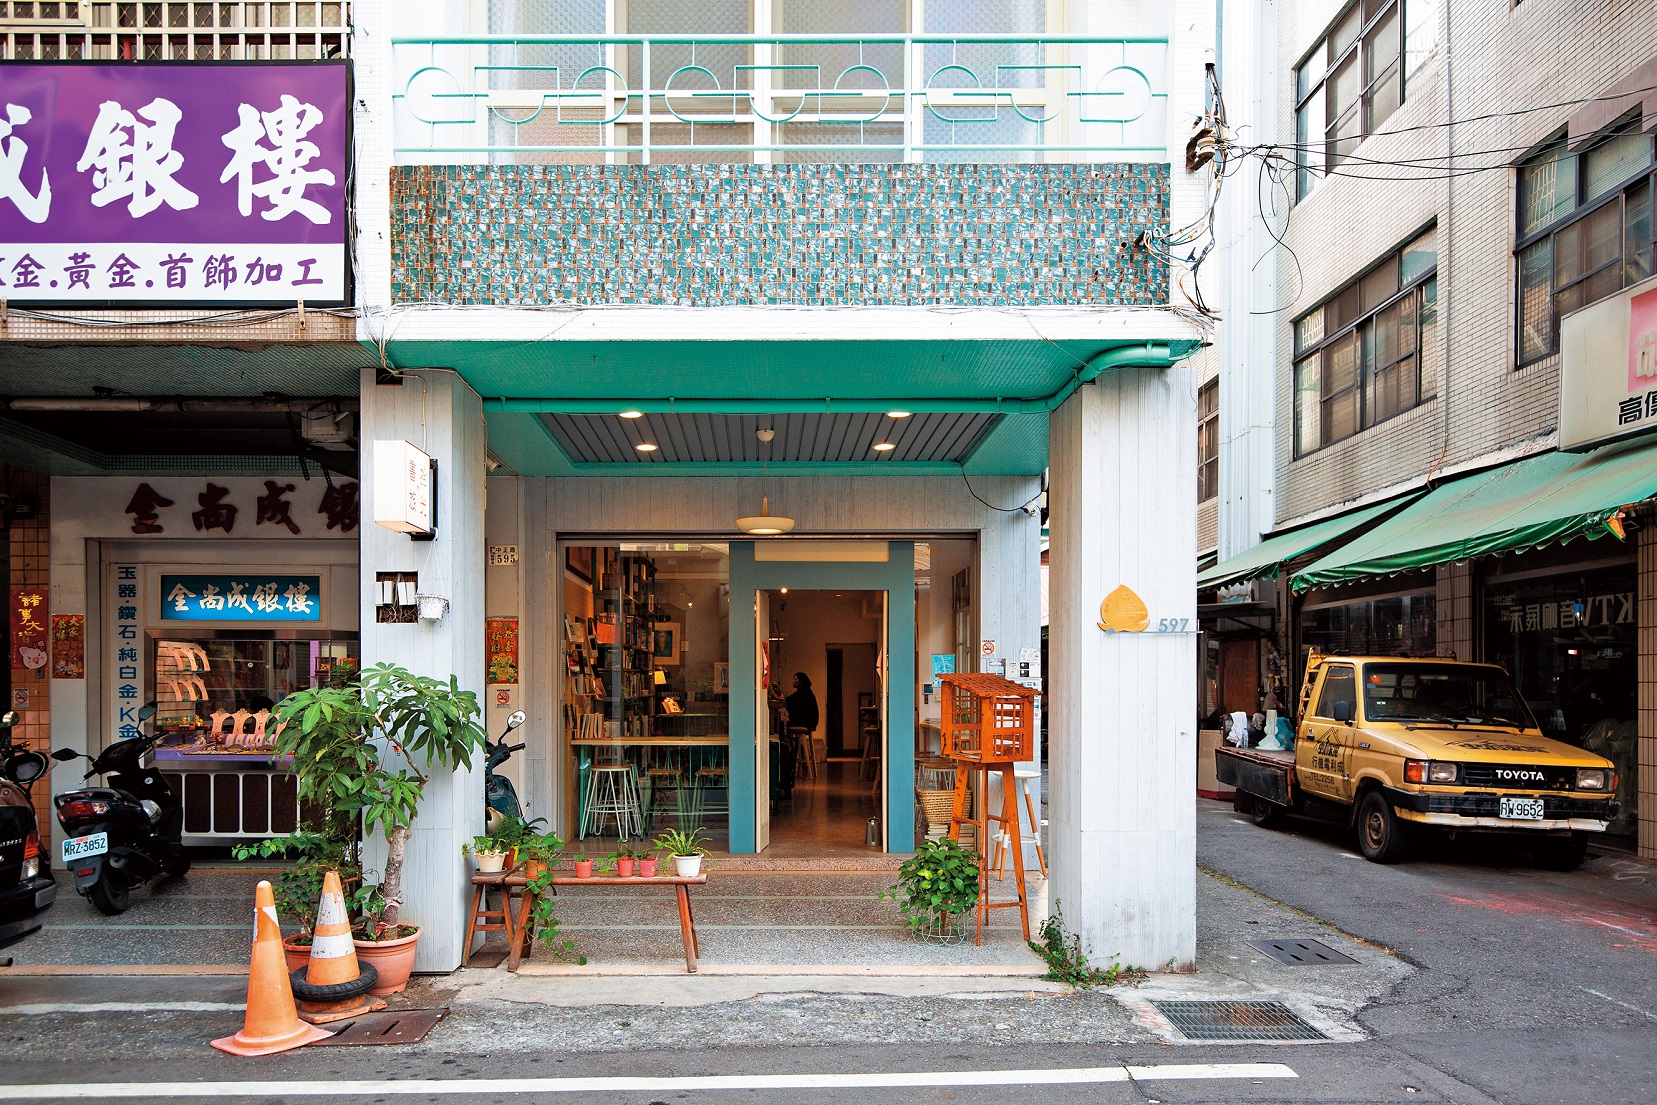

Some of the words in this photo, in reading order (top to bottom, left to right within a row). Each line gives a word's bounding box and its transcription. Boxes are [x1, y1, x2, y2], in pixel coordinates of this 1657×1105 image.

[0, 252, 324, 291] 金.黃金.首飾加工
[497, 553, 516, 564] 595
[1158, 618, 1189, 633] 597
[1495, 769, 1545, 781] TOYOTA
